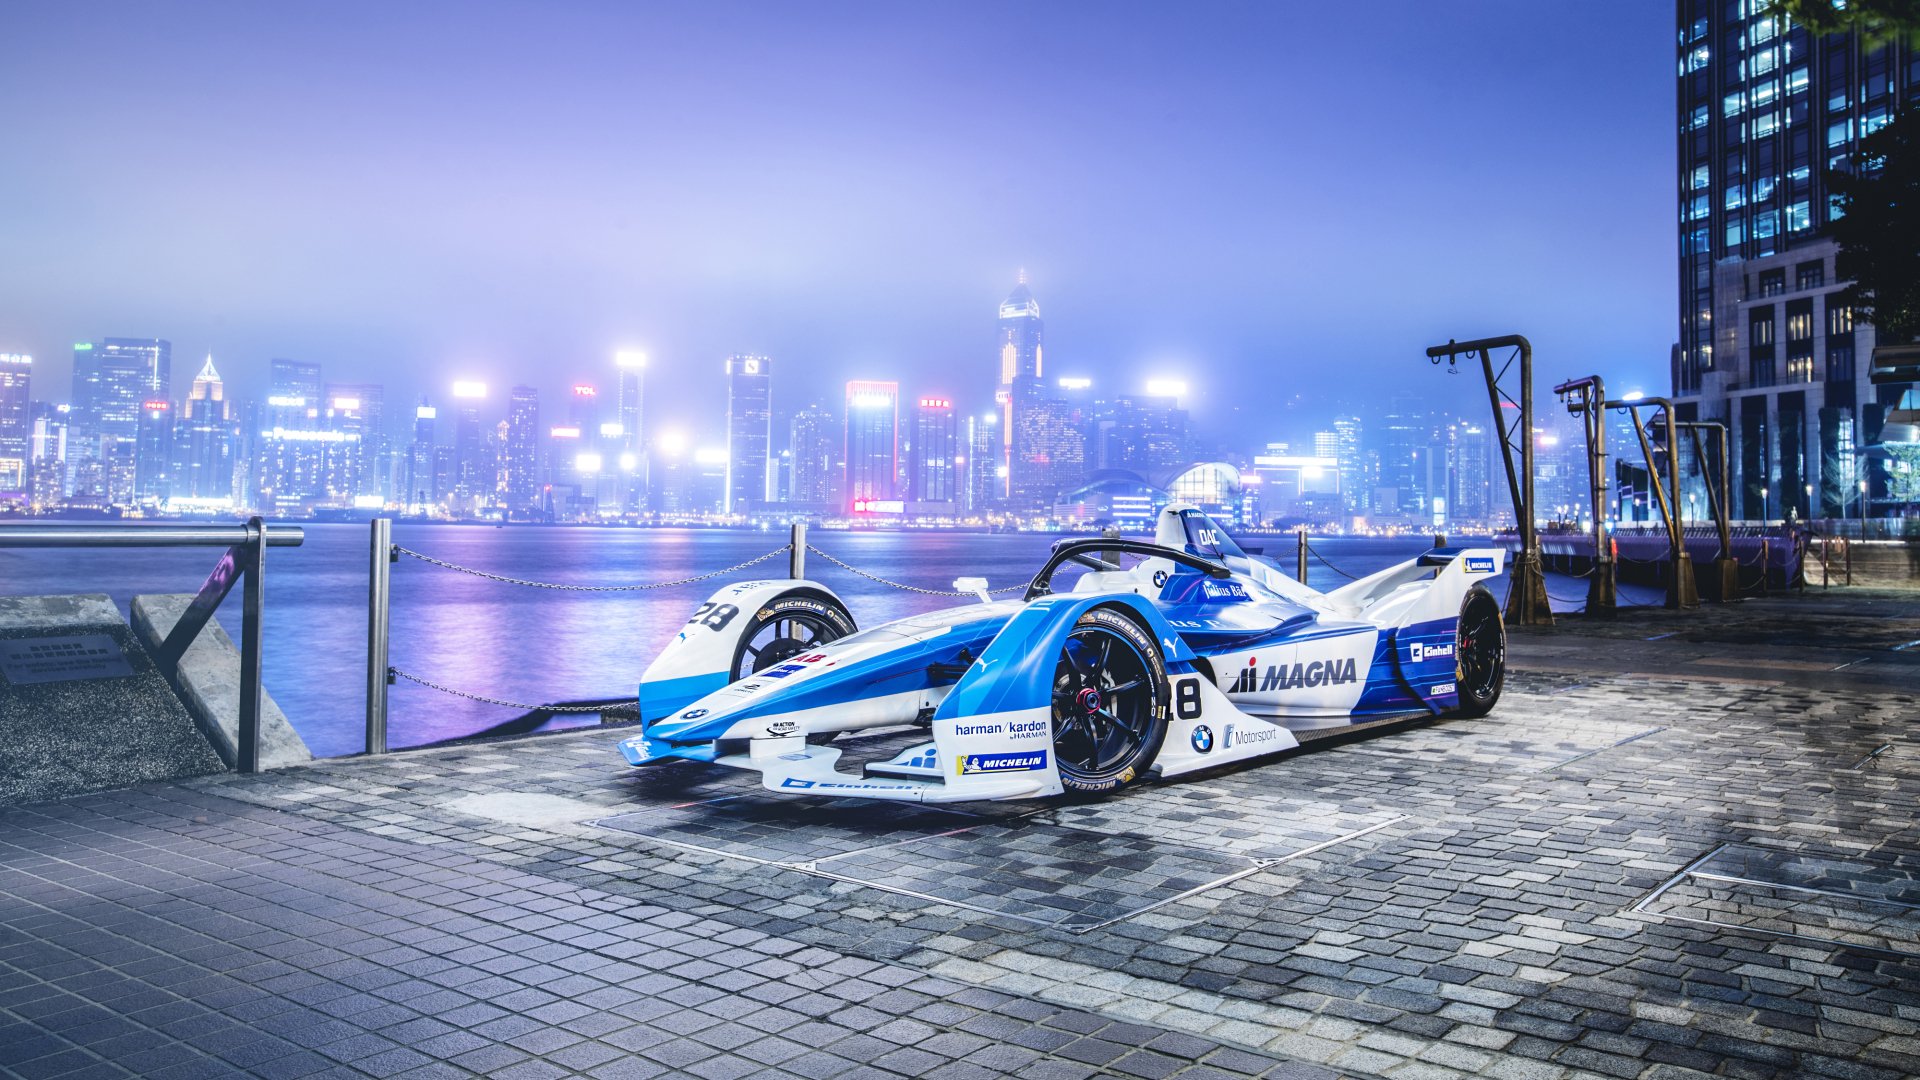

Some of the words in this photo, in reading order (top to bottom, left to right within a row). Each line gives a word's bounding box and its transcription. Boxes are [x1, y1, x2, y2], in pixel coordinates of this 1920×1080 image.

[1471, 561, 1493, 569] MICHELIN
[1202, 584, 1231, 600] Julius
[775, 600, 825, 612] MICHELIN
[688, 602, 740, 632] 28
[1097, 612, 1147, 646] MICHELIN
[1423, 645, 1453, 657] Einhell
[1260, 658, 1357, 692] MAGNA
[1014, 731, 1047, 739] HARMAN
[1235, 727, 1277, 745] Motorsport
[982, 757, 1042, 768] MICHELIN
[818, 782, 913, 791] Einhell
[1061, 776, 1117, 792] MICHELIN
